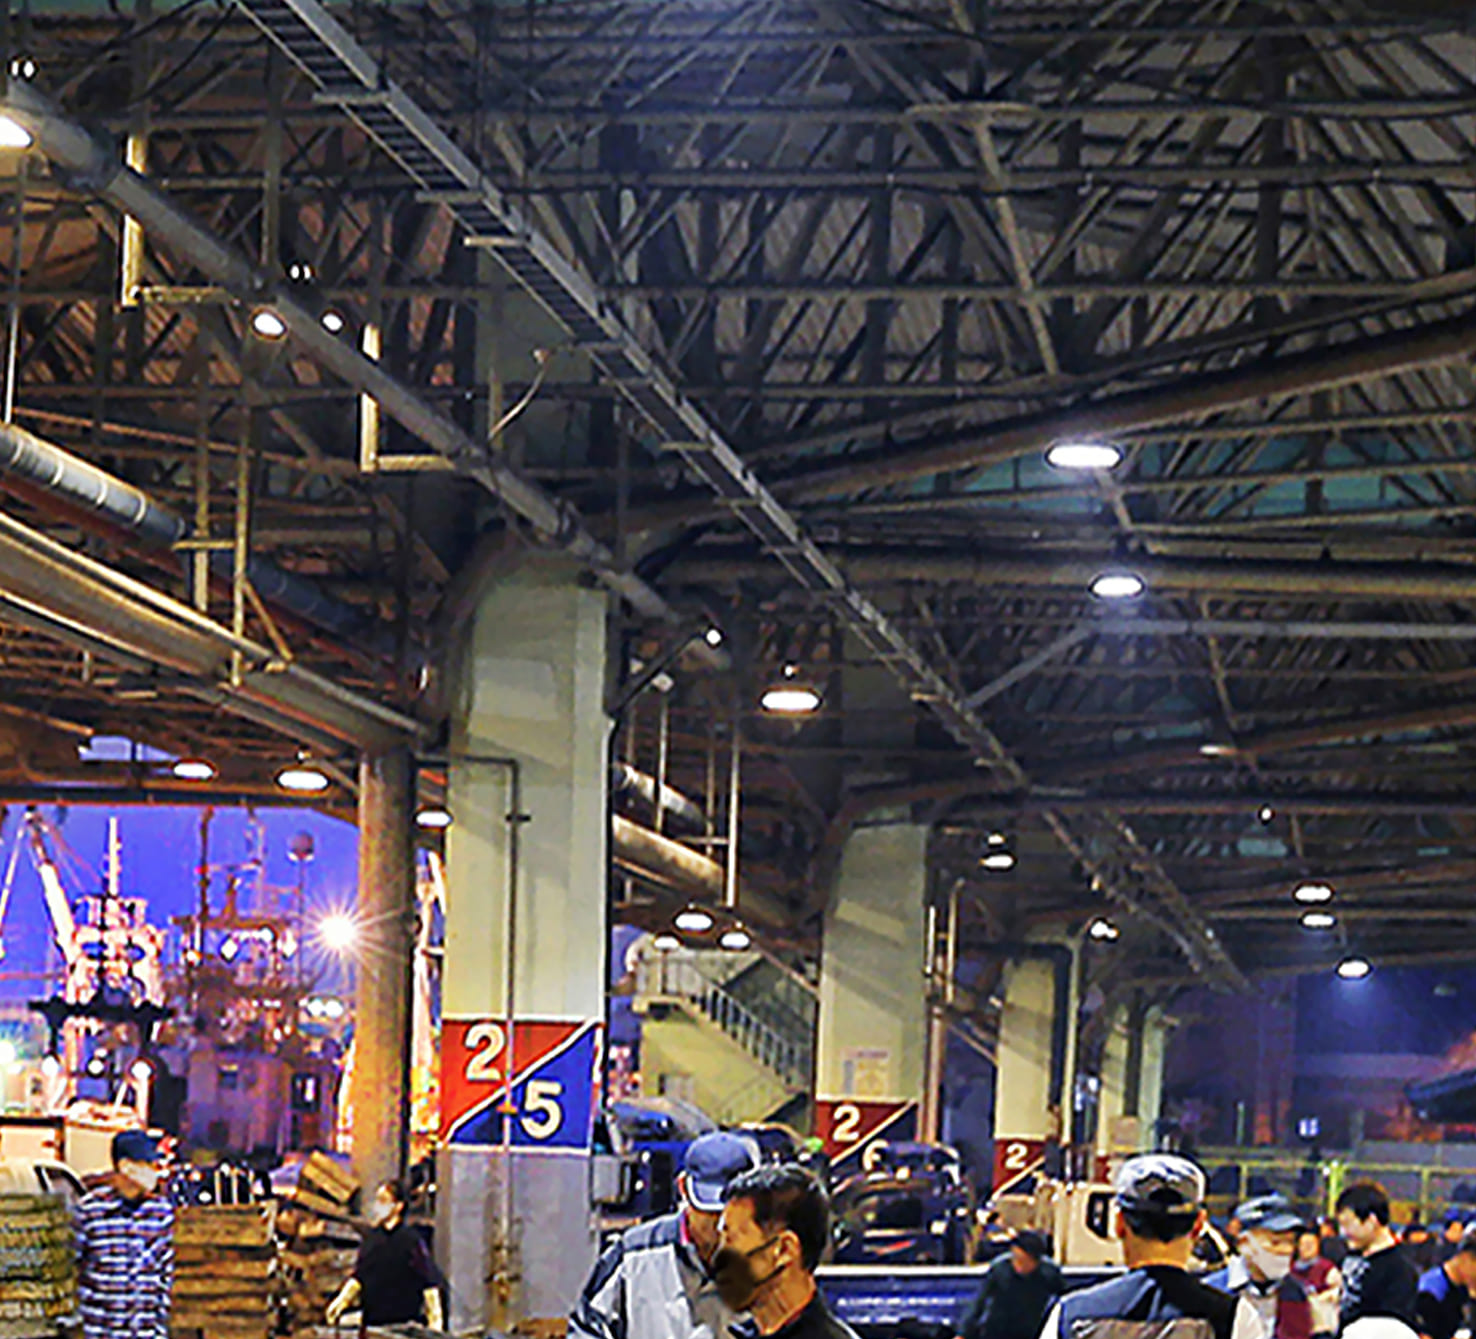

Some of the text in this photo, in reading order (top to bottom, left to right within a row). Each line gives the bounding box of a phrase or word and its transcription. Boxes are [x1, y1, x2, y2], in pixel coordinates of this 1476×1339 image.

[464, 1022, 506, 1081] 2
[520, 1079, 563, 1140] 5
[832, 1105, 860, 1141] 2
[1004, 1143, 1029, 1169] 2
